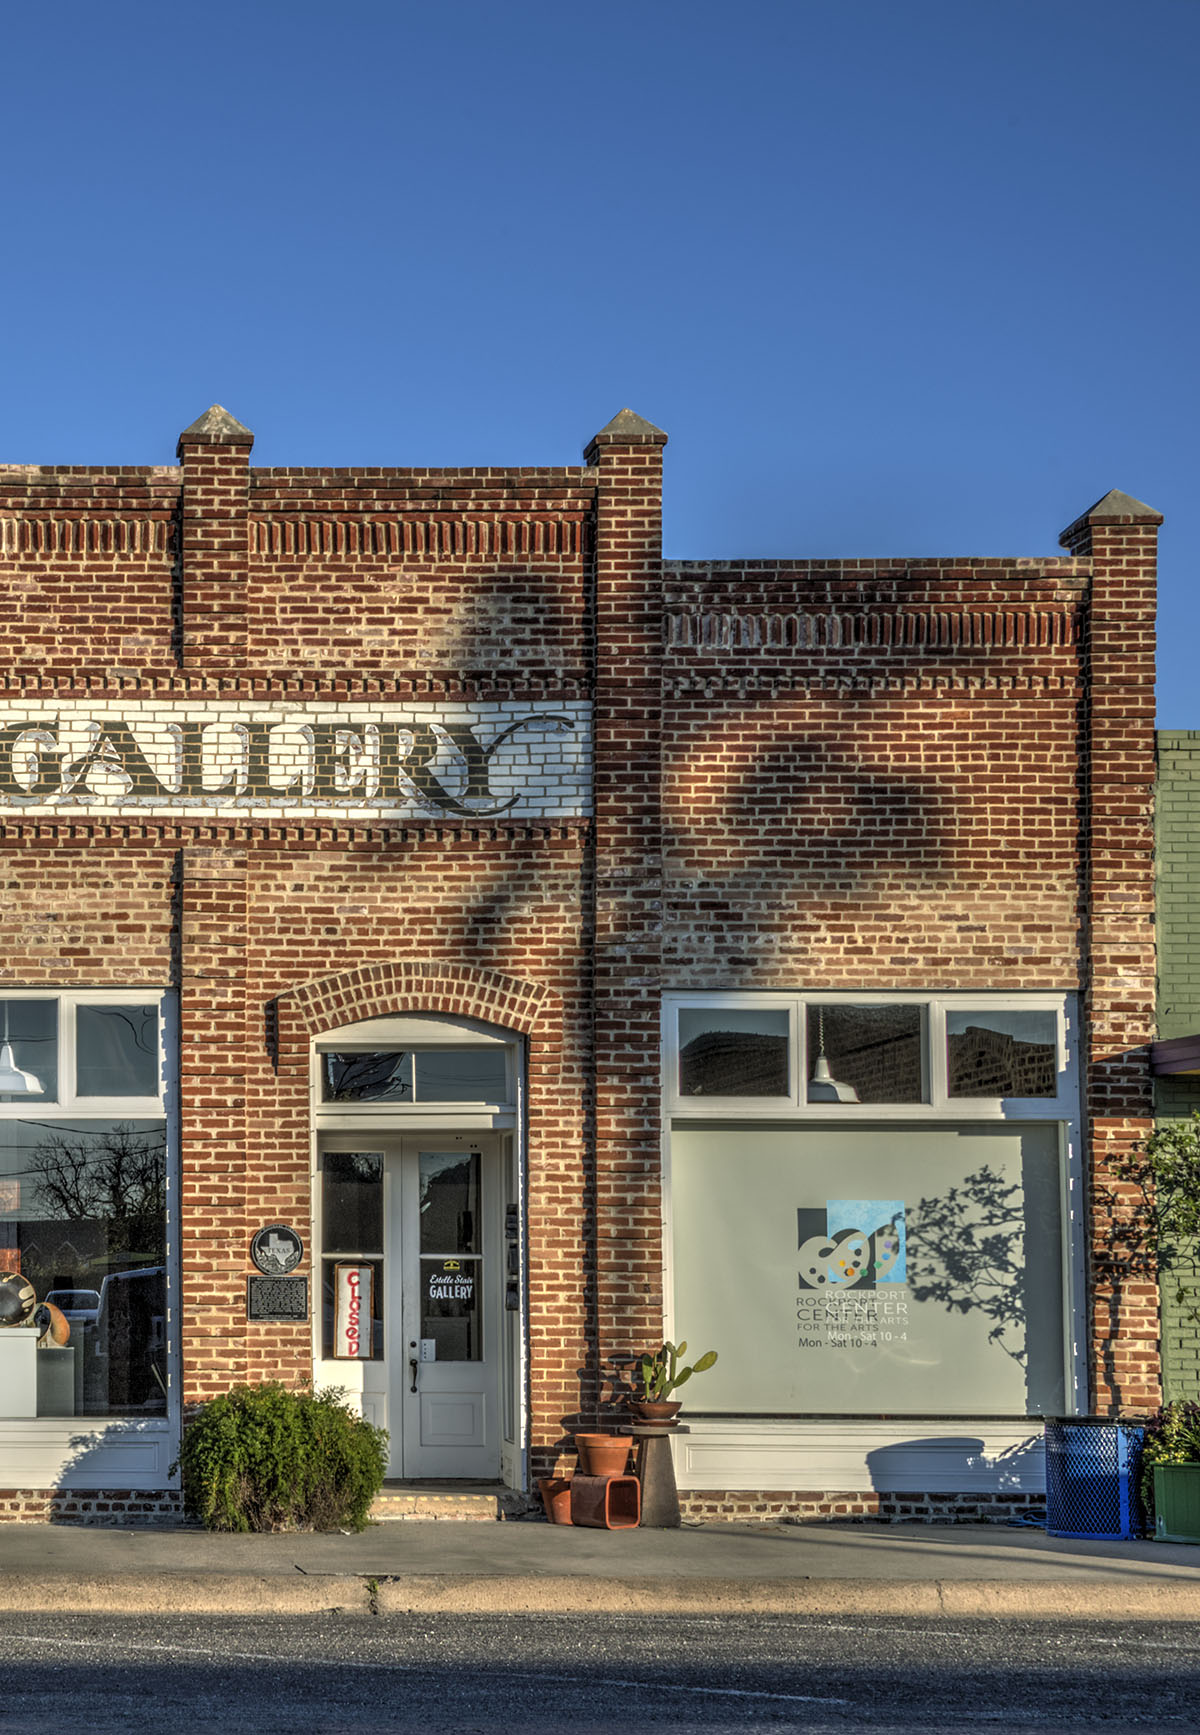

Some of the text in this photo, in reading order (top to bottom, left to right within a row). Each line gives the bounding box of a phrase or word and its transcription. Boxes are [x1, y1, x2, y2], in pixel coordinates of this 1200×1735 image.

[430, 1274, 454, 1284] Estelle
[430, 1285, 473, 1299] GALLERY
[825, 1290, 907, 1300] ROCKPORT
[825, 1302, 908, 1314] CENTER
[826, 1317, 849, 1325] FOR
[880, 1317, 909, 1325] ARTS
[827, 1332, 851, 1341] Mon
[860, 1332, 876, 1341] Sat
[880, 1332, 892, 1341] 10
[900, 1332, 907, 1341] 4
